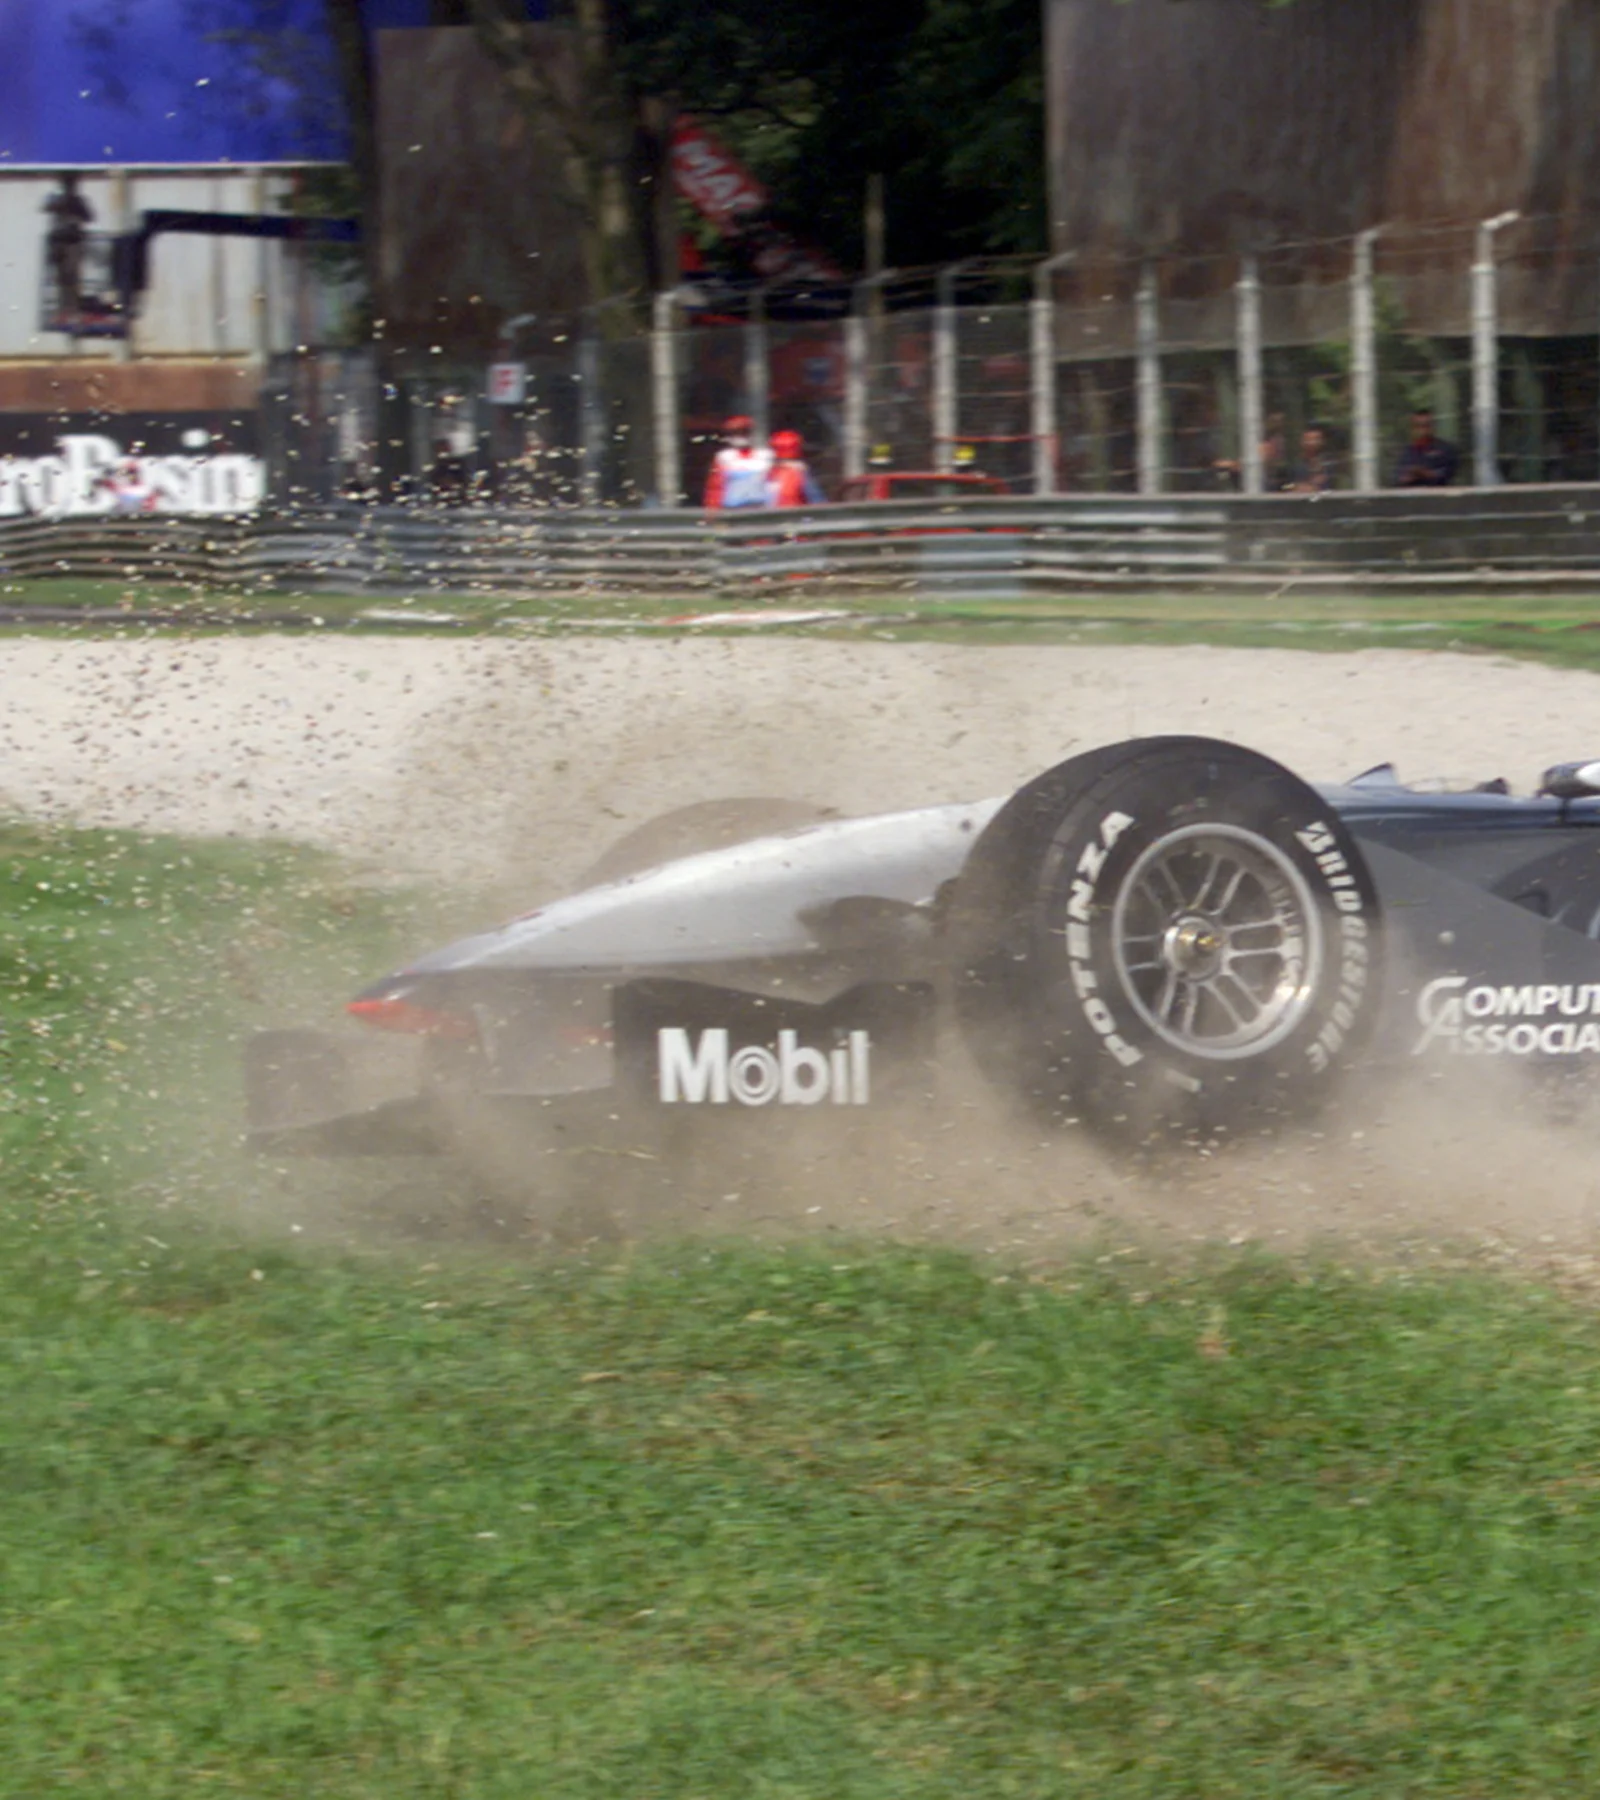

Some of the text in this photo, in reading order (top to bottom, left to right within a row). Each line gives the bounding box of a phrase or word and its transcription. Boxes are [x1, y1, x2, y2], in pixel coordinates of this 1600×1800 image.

[1066, 810, 1145, 1067] POTENZA
[1295, 820, 1369, 1074] BRIDGESTONE
[658, 1027, 870, 1107] Mobil
